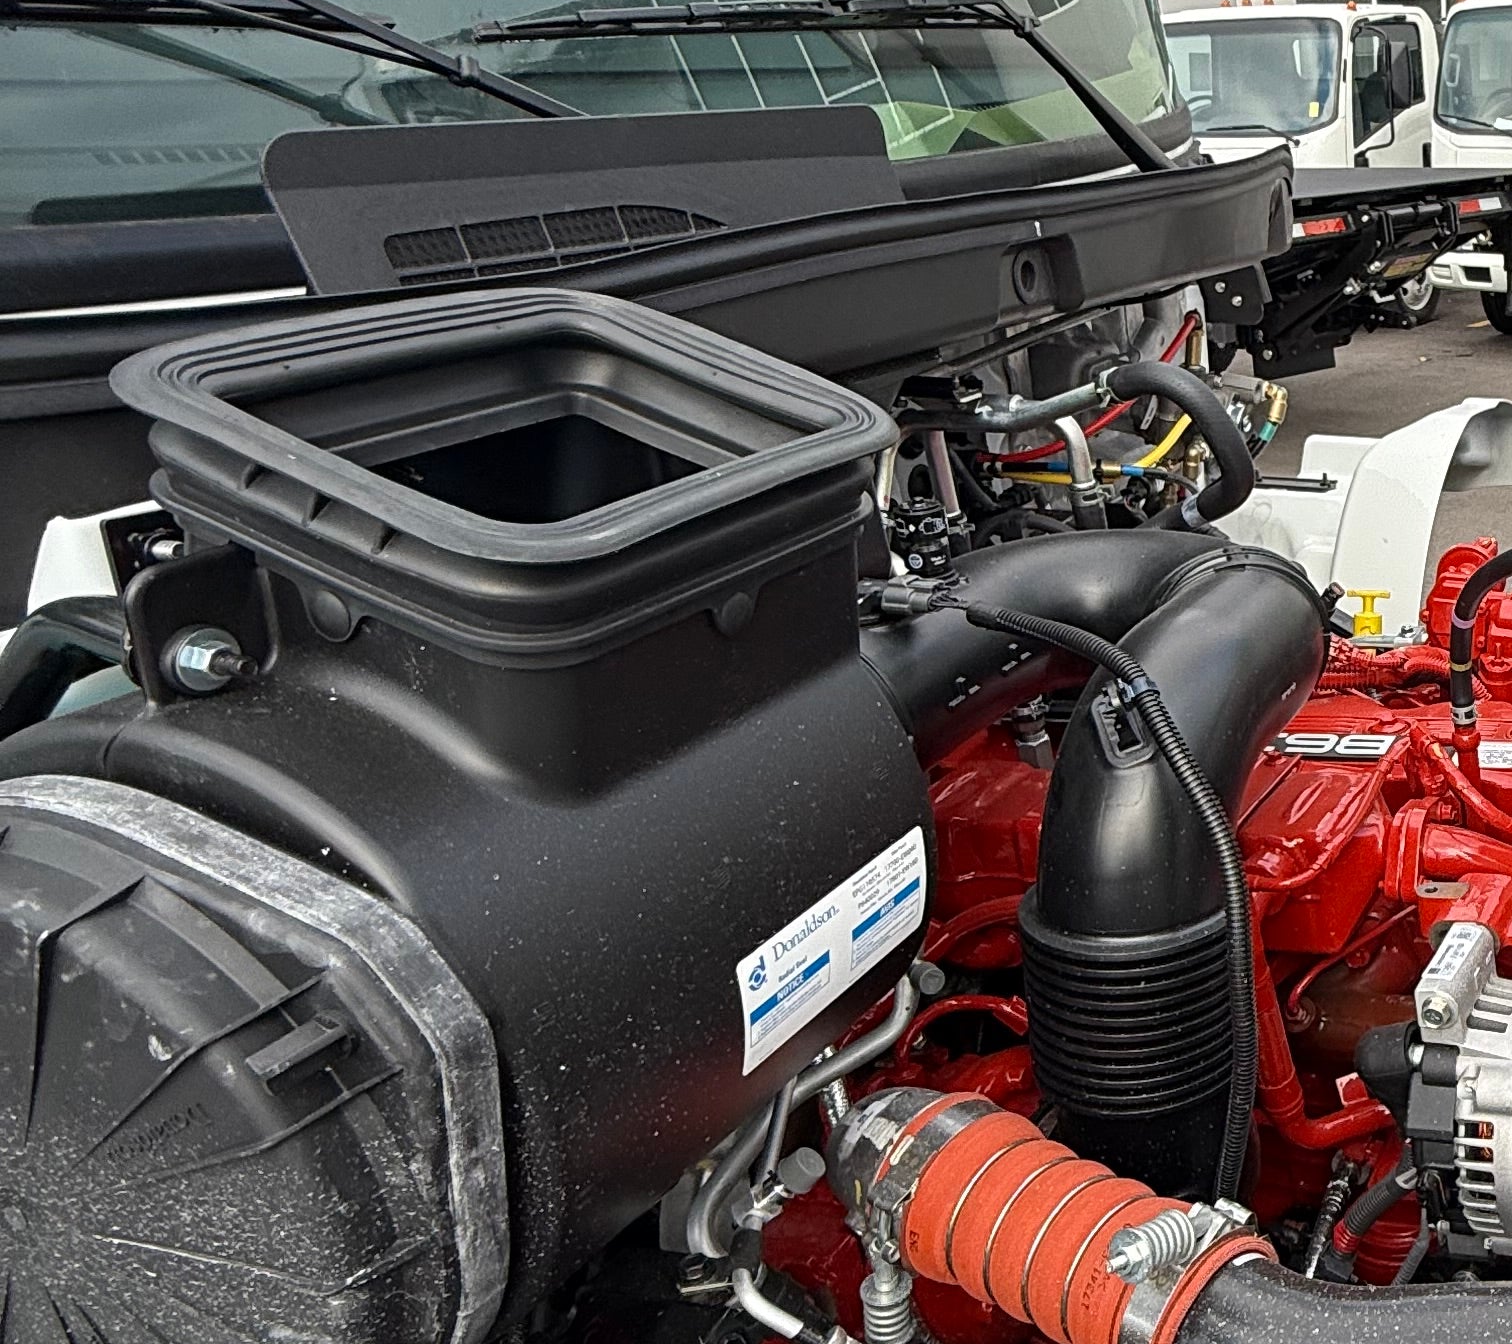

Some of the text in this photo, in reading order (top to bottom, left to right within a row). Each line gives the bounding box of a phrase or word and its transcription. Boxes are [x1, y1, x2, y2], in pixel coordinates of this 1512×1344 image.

[1263, 733, 1396, 755] B6.
[771, 904, 837, 962] Donaldson
[776, 972, 807, 1003] NOTICE
